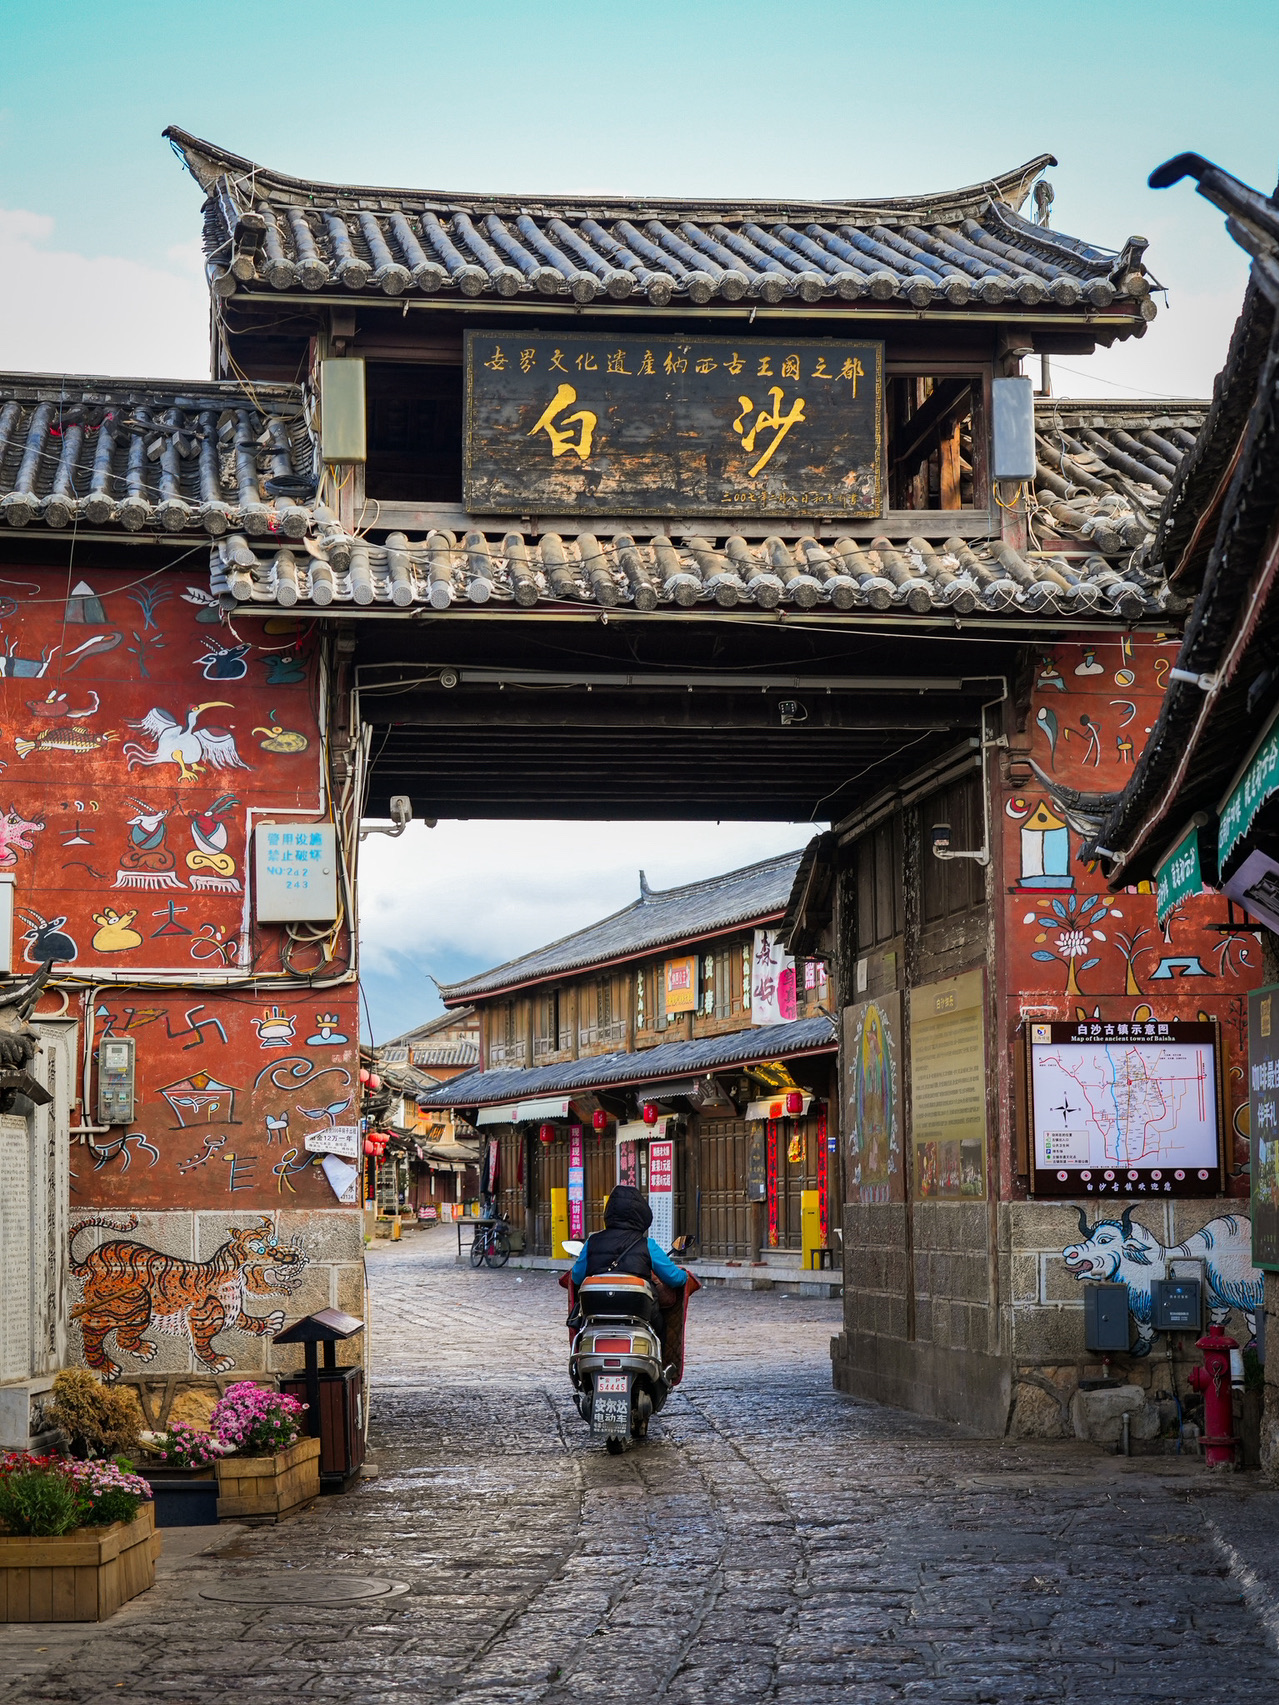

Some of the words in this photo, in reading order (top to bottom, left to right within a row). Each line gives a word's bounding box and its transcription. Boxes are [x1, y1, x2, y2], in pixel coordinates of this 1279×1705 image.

[527, 383, 805, 477] 白沙
[268, 832, 323, 846] 警用设施
[268, 849, 322, 862] 禁止破坏
[286, 881, 309, 889] 243
[1077, 1024, 1169, 1036] 白沙古镇示意图
[594, 1398, 628, 1414] 安尔达
[594, 1413, 628, 1423] 电动车
